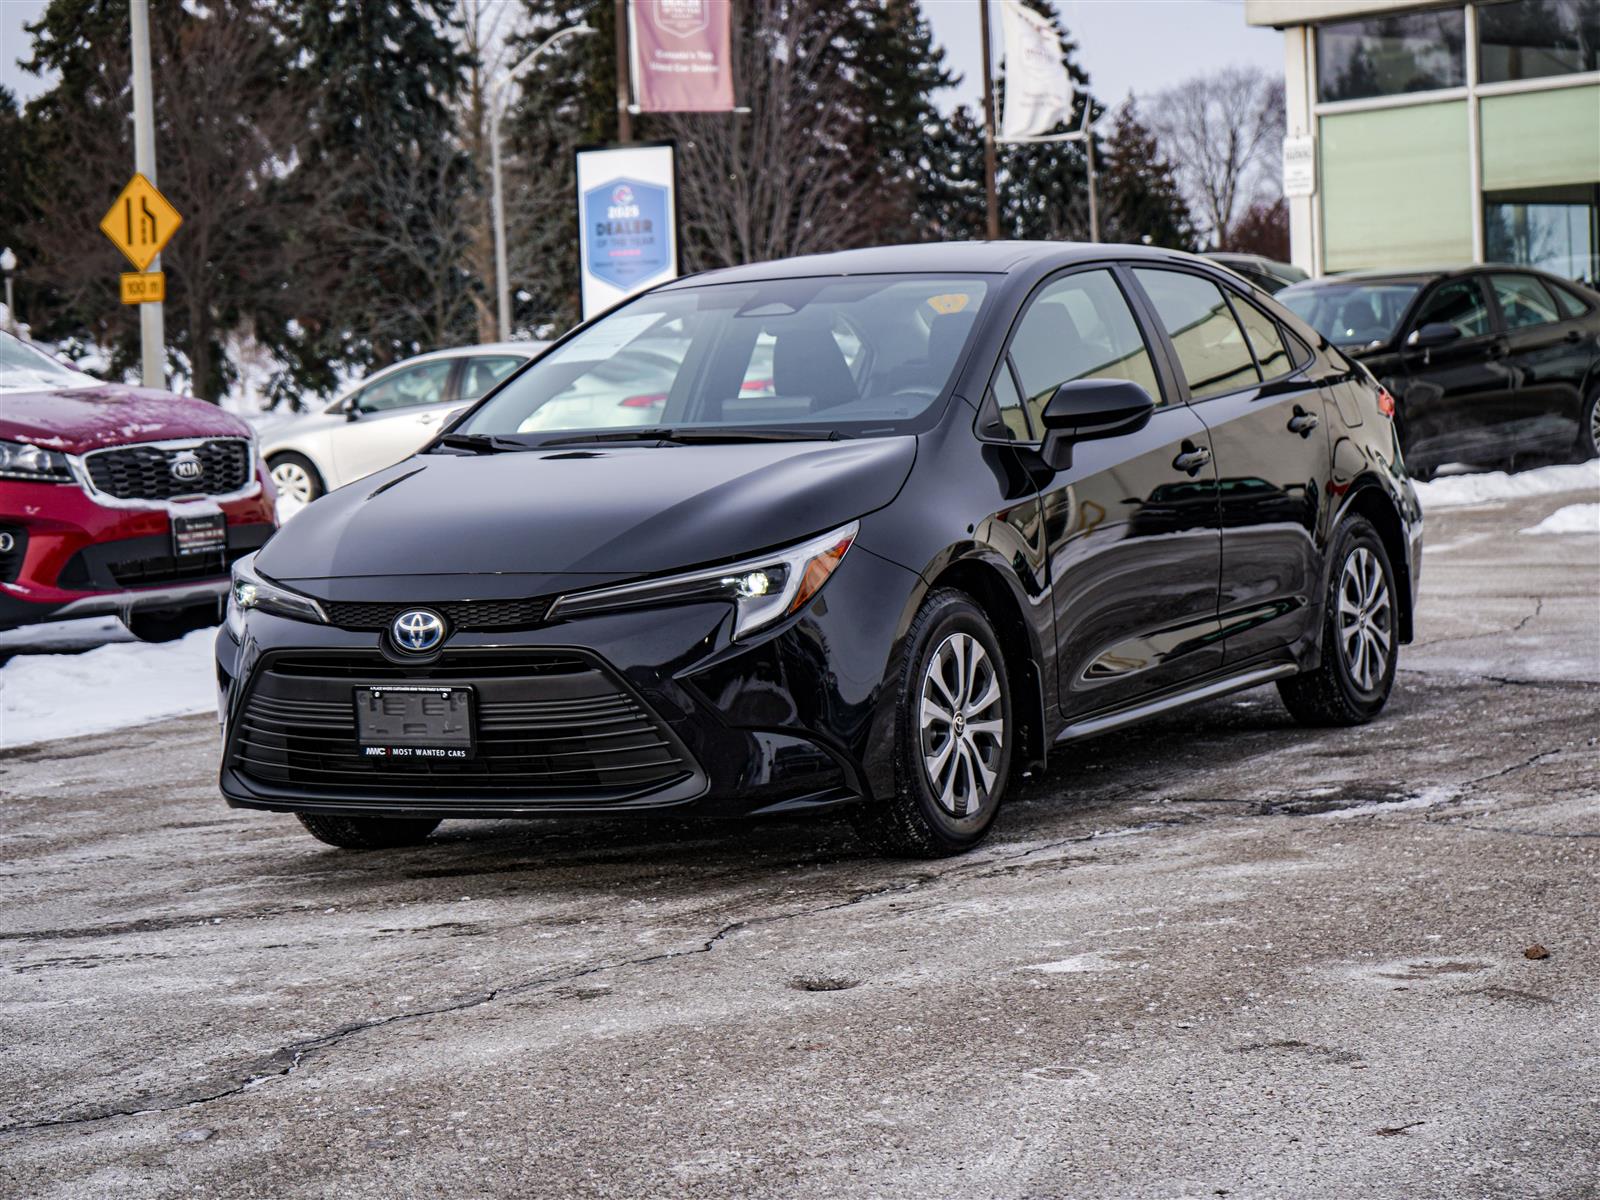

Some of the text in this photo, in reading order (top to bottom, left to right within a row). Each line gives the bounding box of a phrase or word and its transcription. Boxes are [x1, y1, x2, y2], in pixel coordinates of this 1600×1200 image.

[595, 219, 653, 236] DEALER
[128, 281, 146, 296] 100
[178, 463, 199, 476] KIA
[392, 748, 413, 756] MOST
[415, 748, 446, 757] WANTED
[447, 750, 466, 758] CARS
